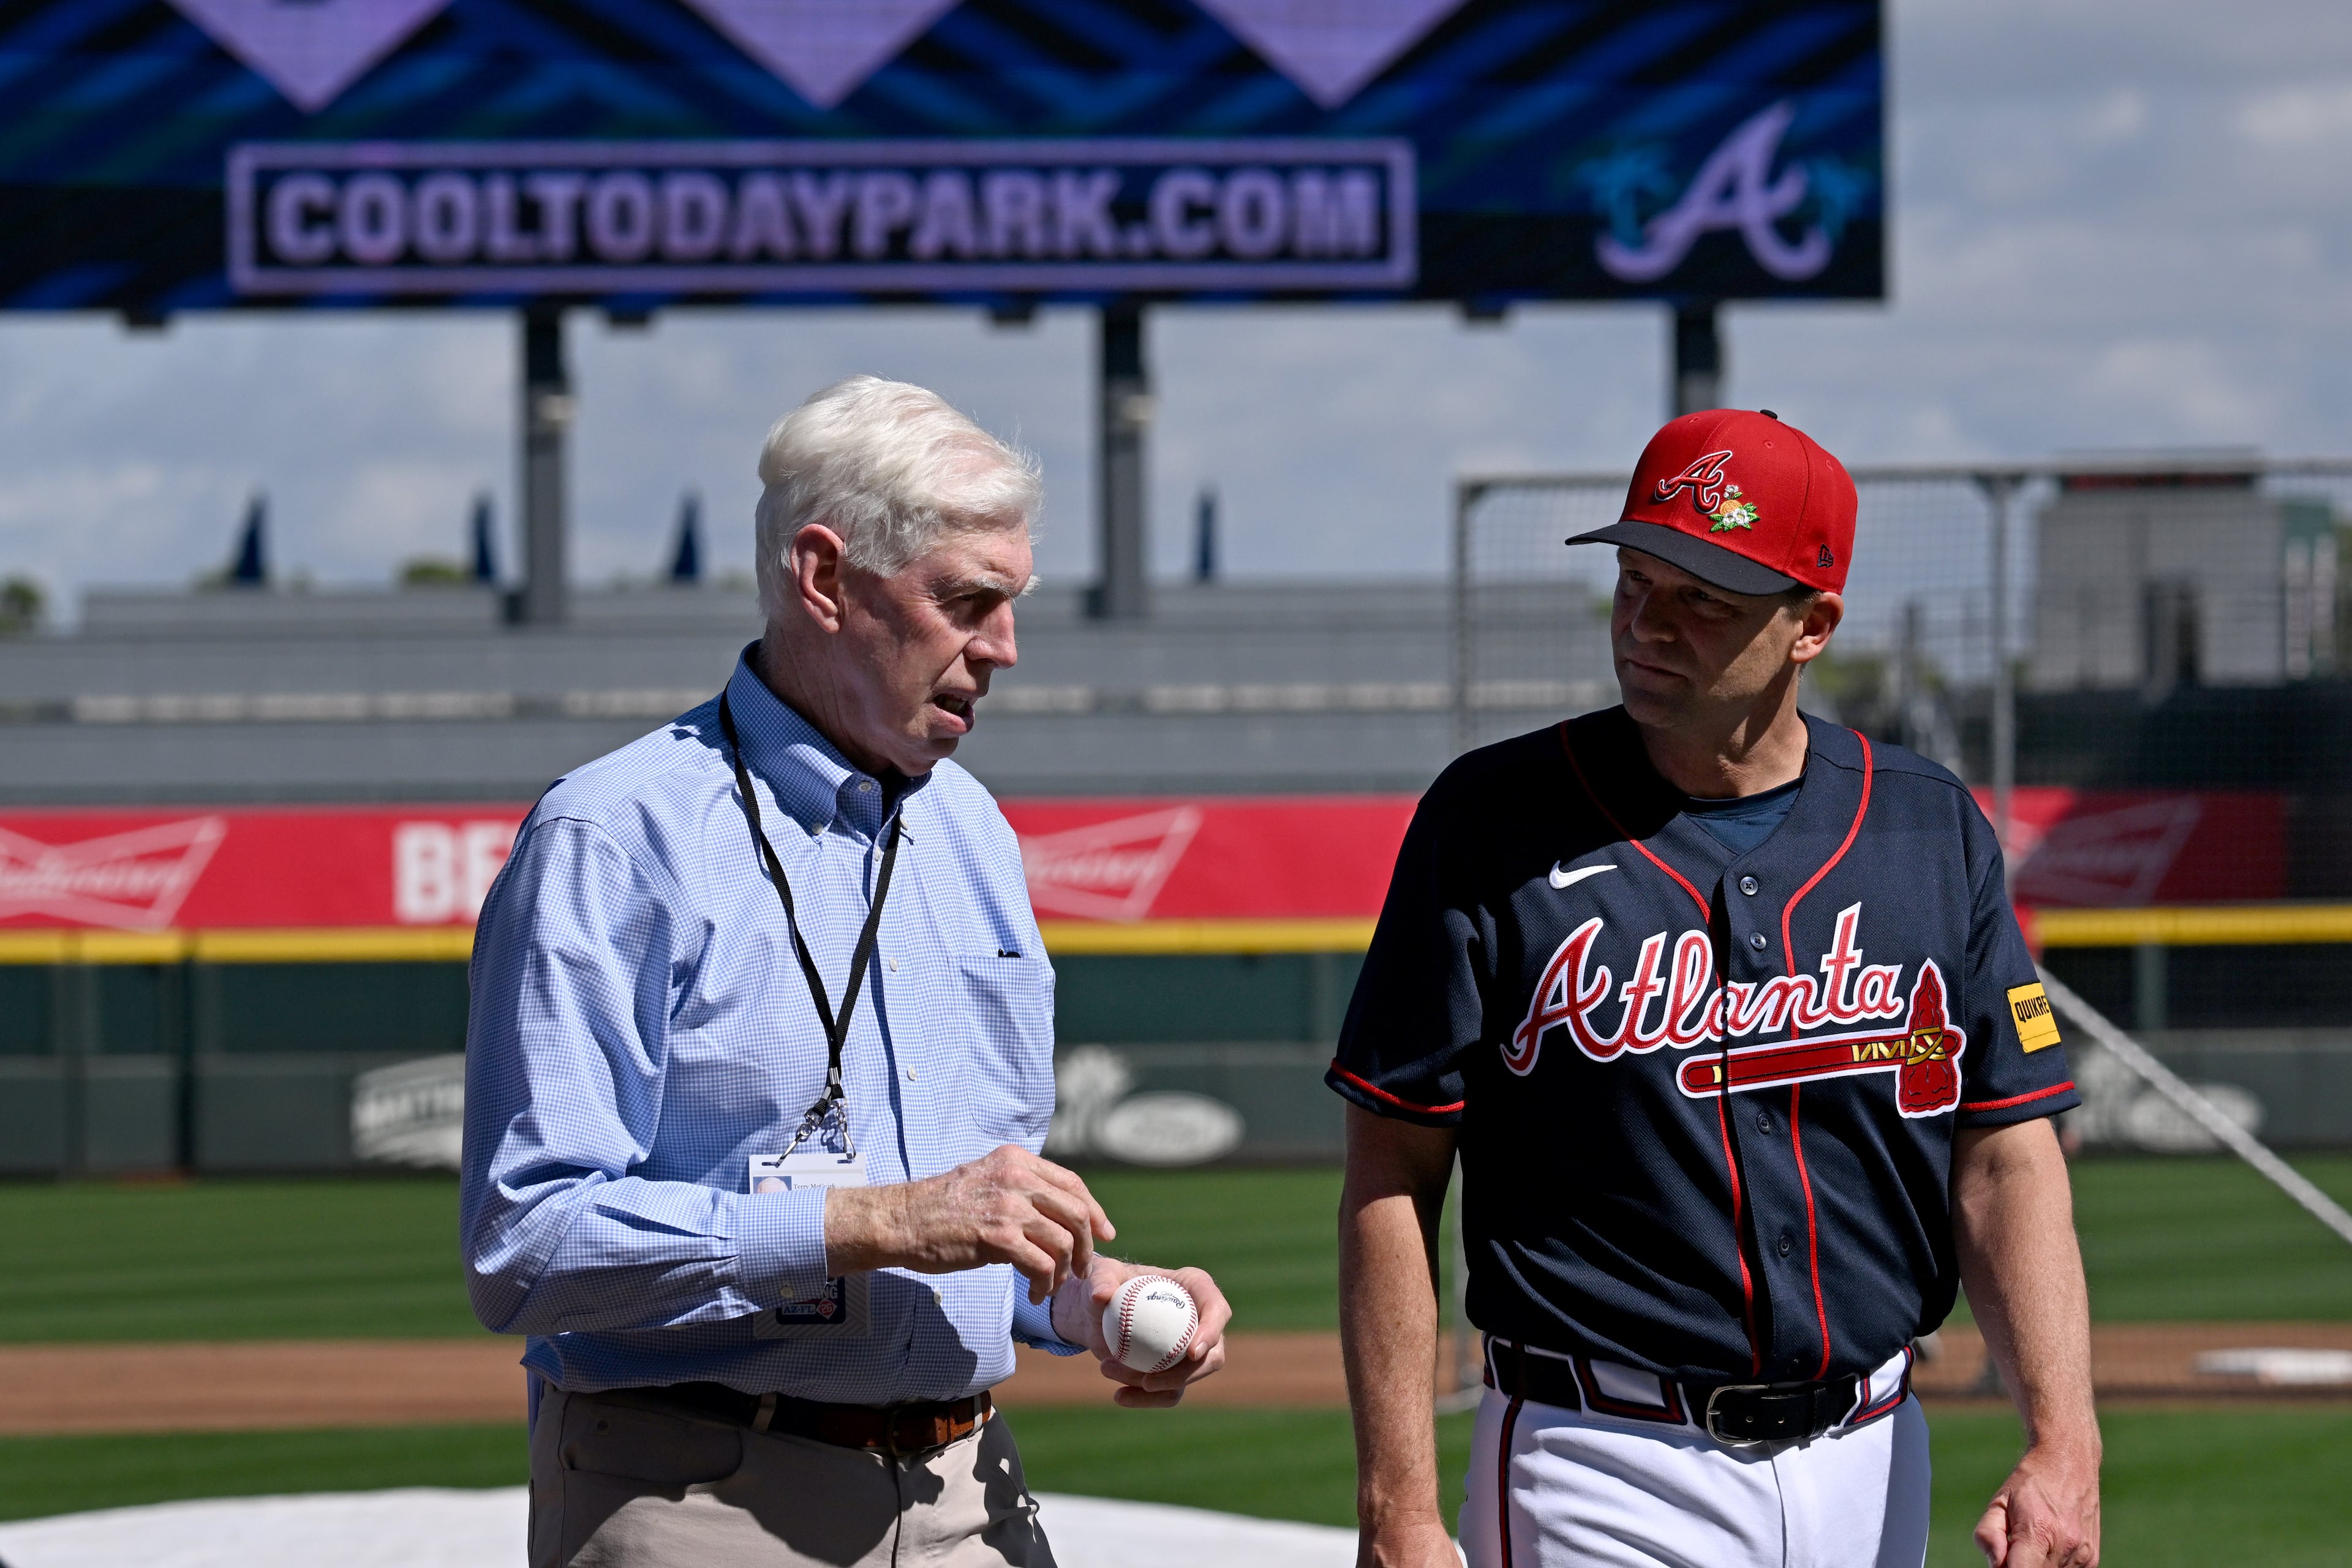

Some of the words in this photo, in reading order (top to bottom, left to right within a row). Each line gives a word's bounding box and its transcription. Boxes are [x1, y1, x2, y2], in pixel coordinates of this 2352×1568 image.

[266, 167, 1381, 263] COOLTODAYPARK.COM
[1654, 450, 1733, 514] A
[1499, 901, 1904, 1077] Atlanta
[821, 1303, 833, 1314] 26
[1146, 1291, 1185, 1309] Rawlings
